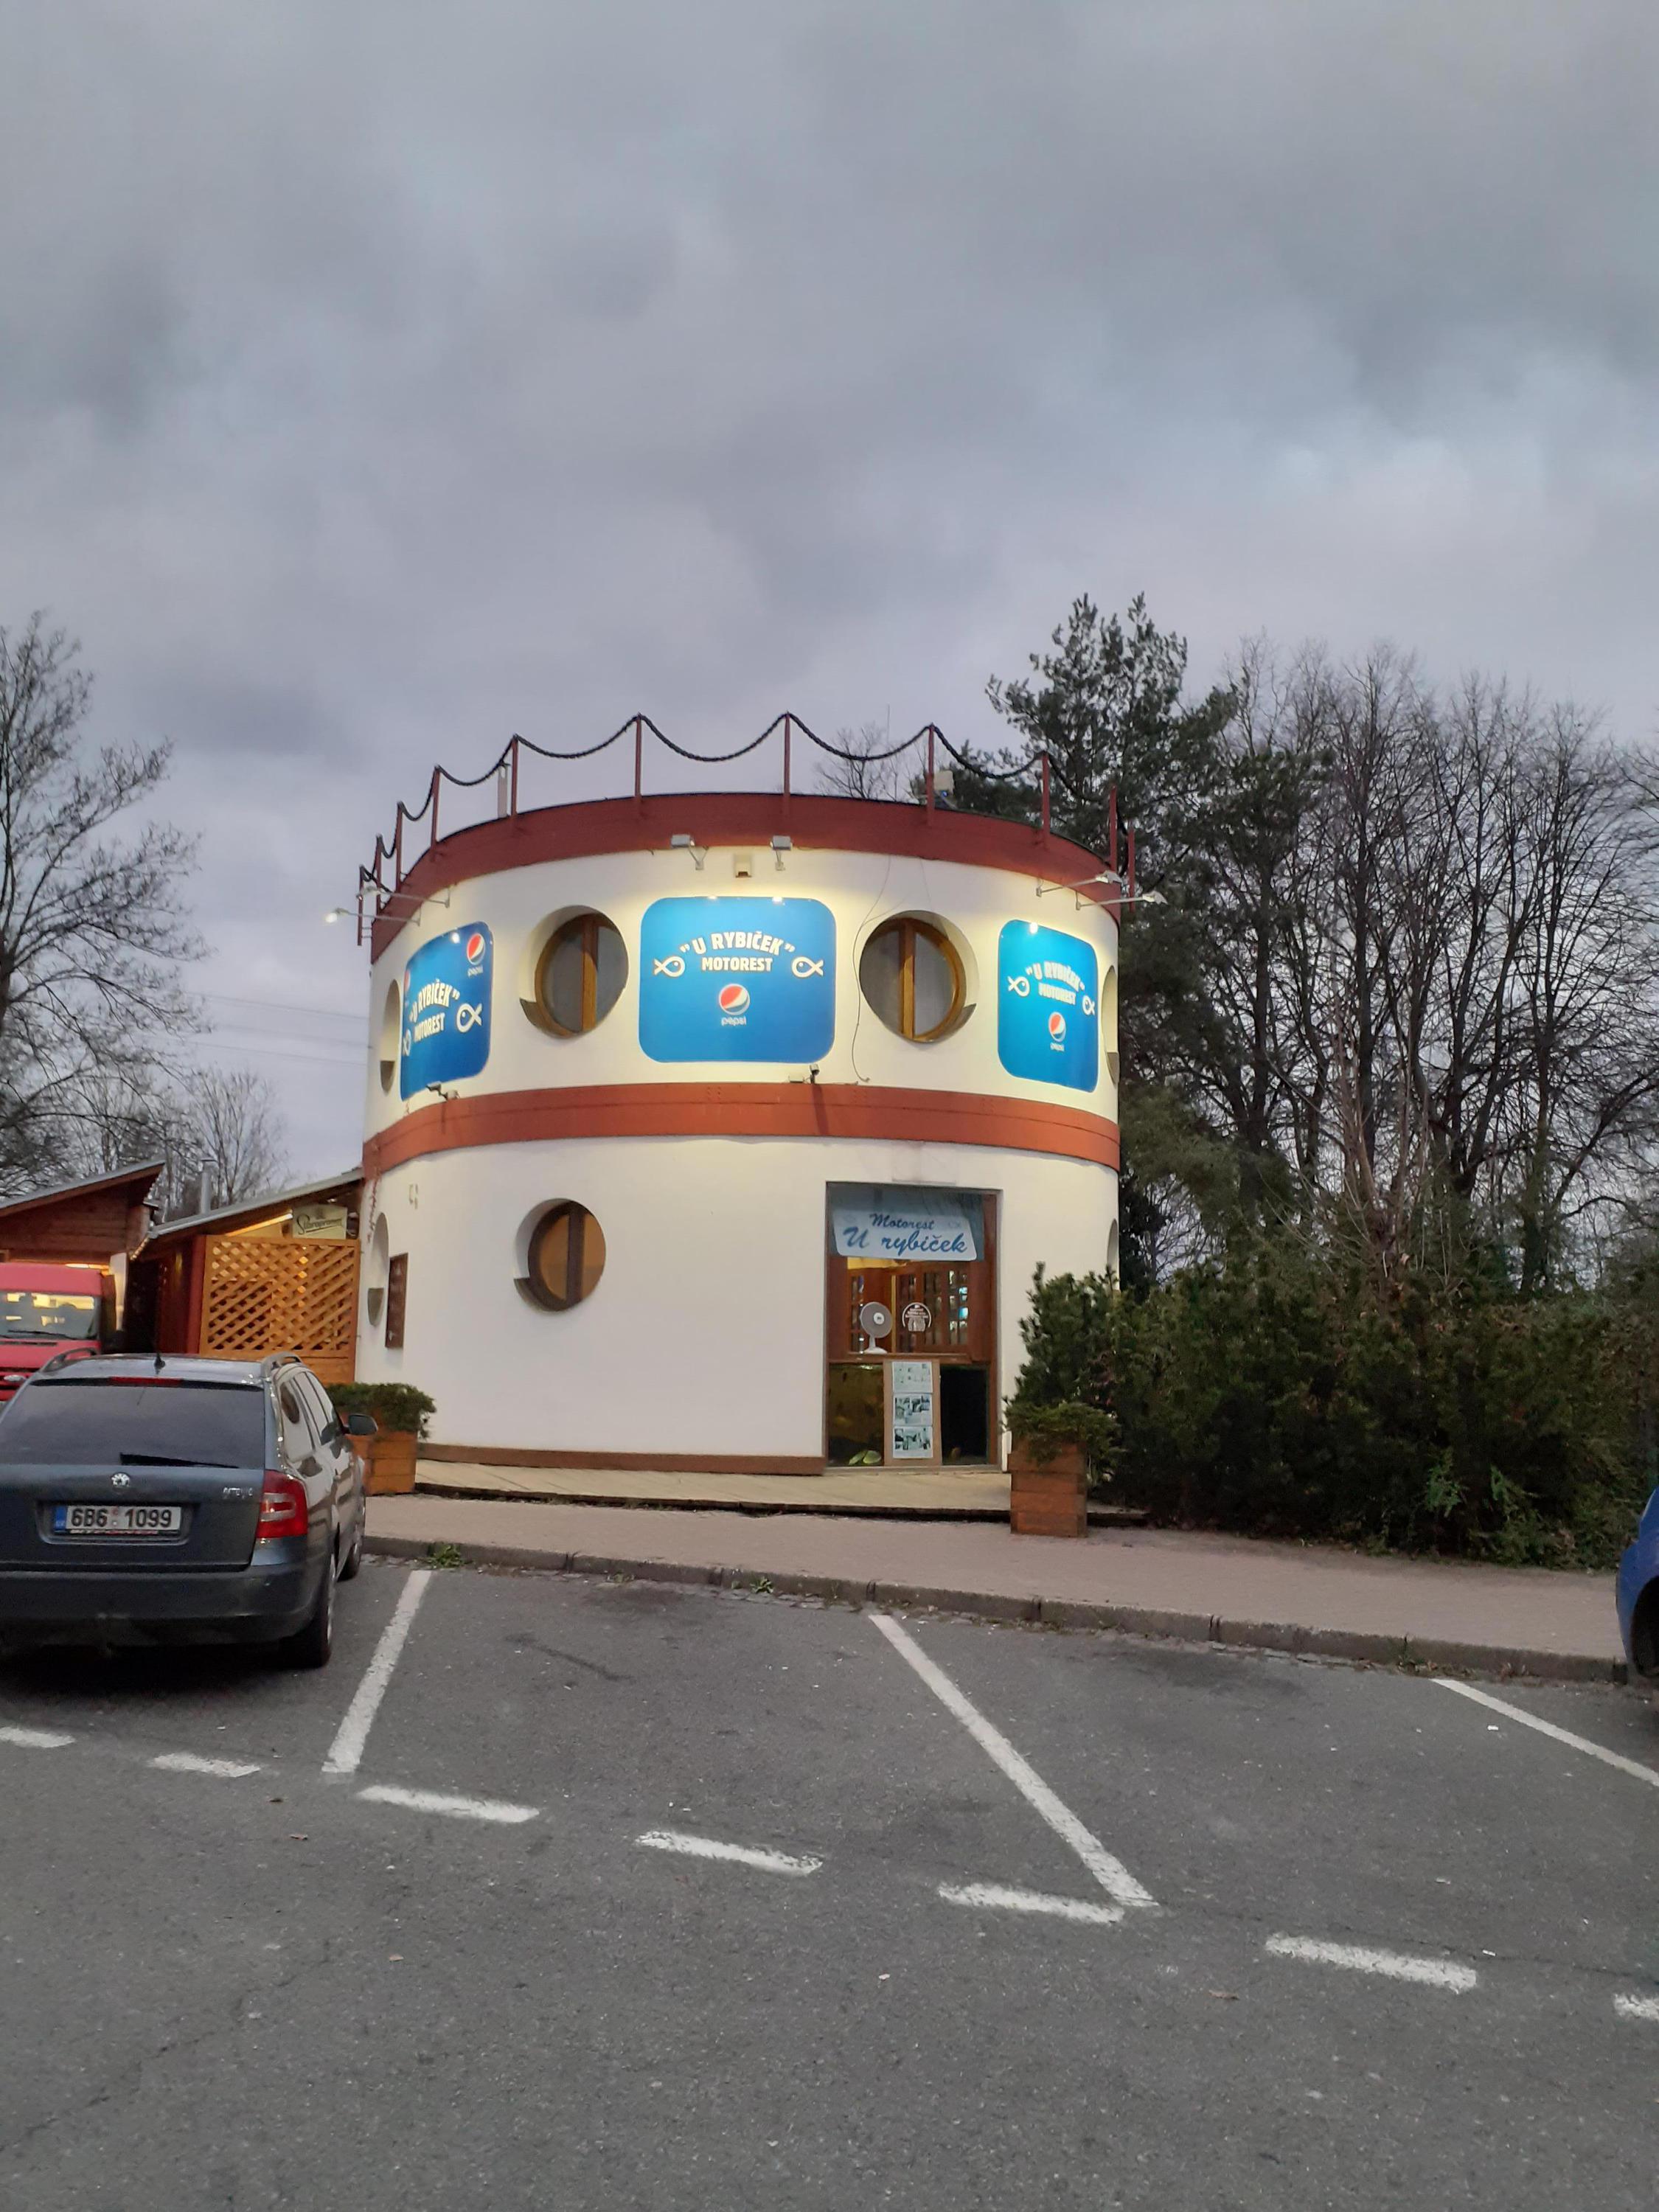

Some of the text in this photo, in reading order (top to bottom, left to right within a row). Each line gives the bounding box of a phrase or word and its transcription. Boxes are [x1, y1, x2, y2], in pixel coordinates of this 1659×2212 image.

[701, 956, 773, 972] MOTOREST
[721, 1017, 747, 1026] pepsi
[869, 1213, 935, 1230] Motorest
[843, 1226, 870, 1248] U
[71, 1507, 173, 1528] 6B6 1099
